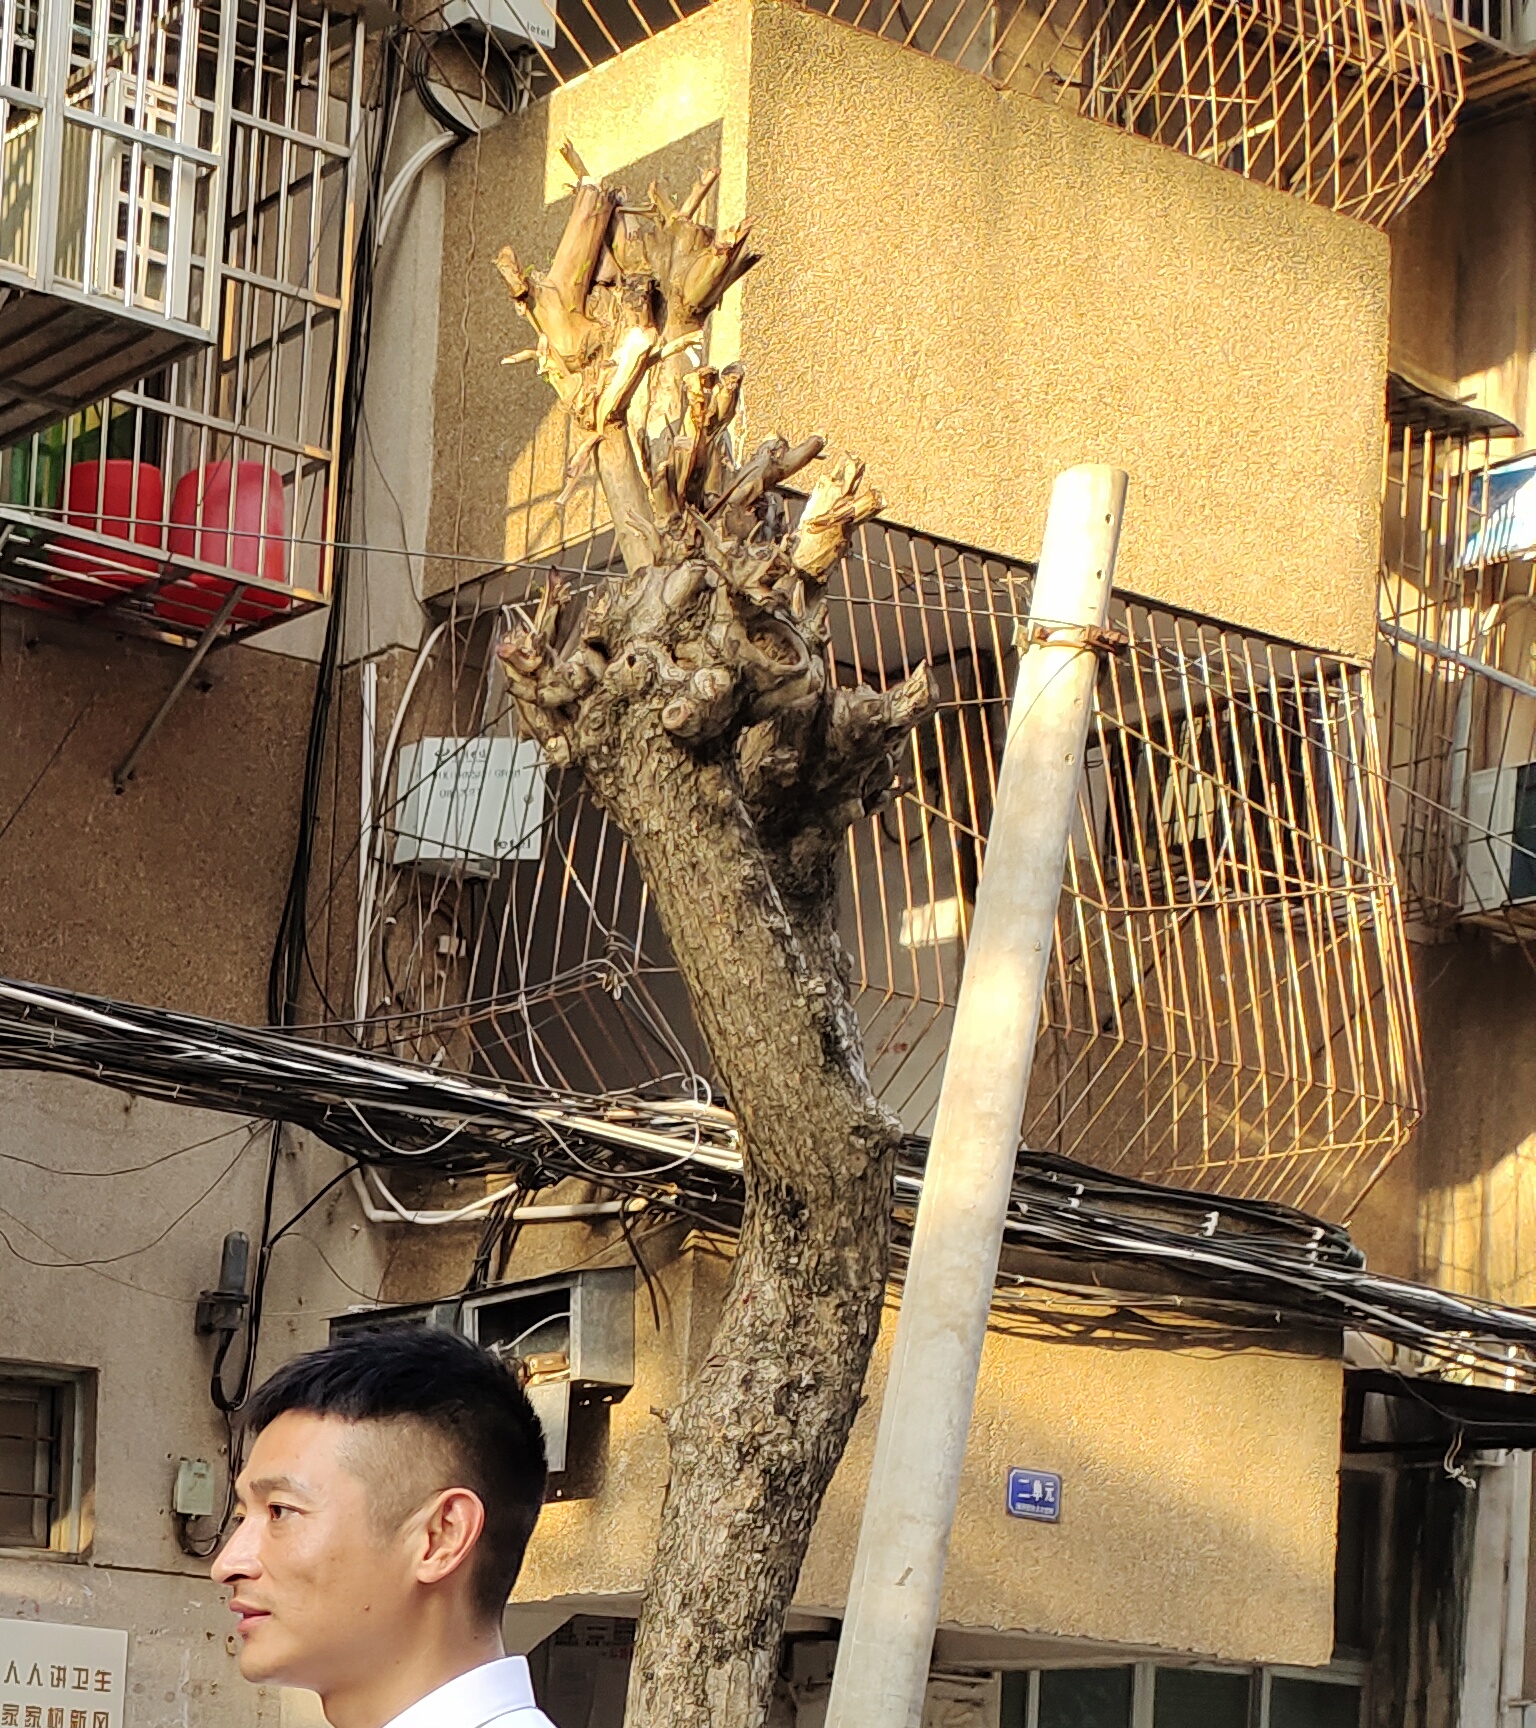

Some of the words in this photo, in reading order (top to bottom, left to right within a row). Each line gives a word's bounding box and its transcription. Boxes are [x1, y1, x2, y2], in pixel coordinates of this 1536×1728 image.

[3, 1660, 112, 1692] 人人讲卫生
